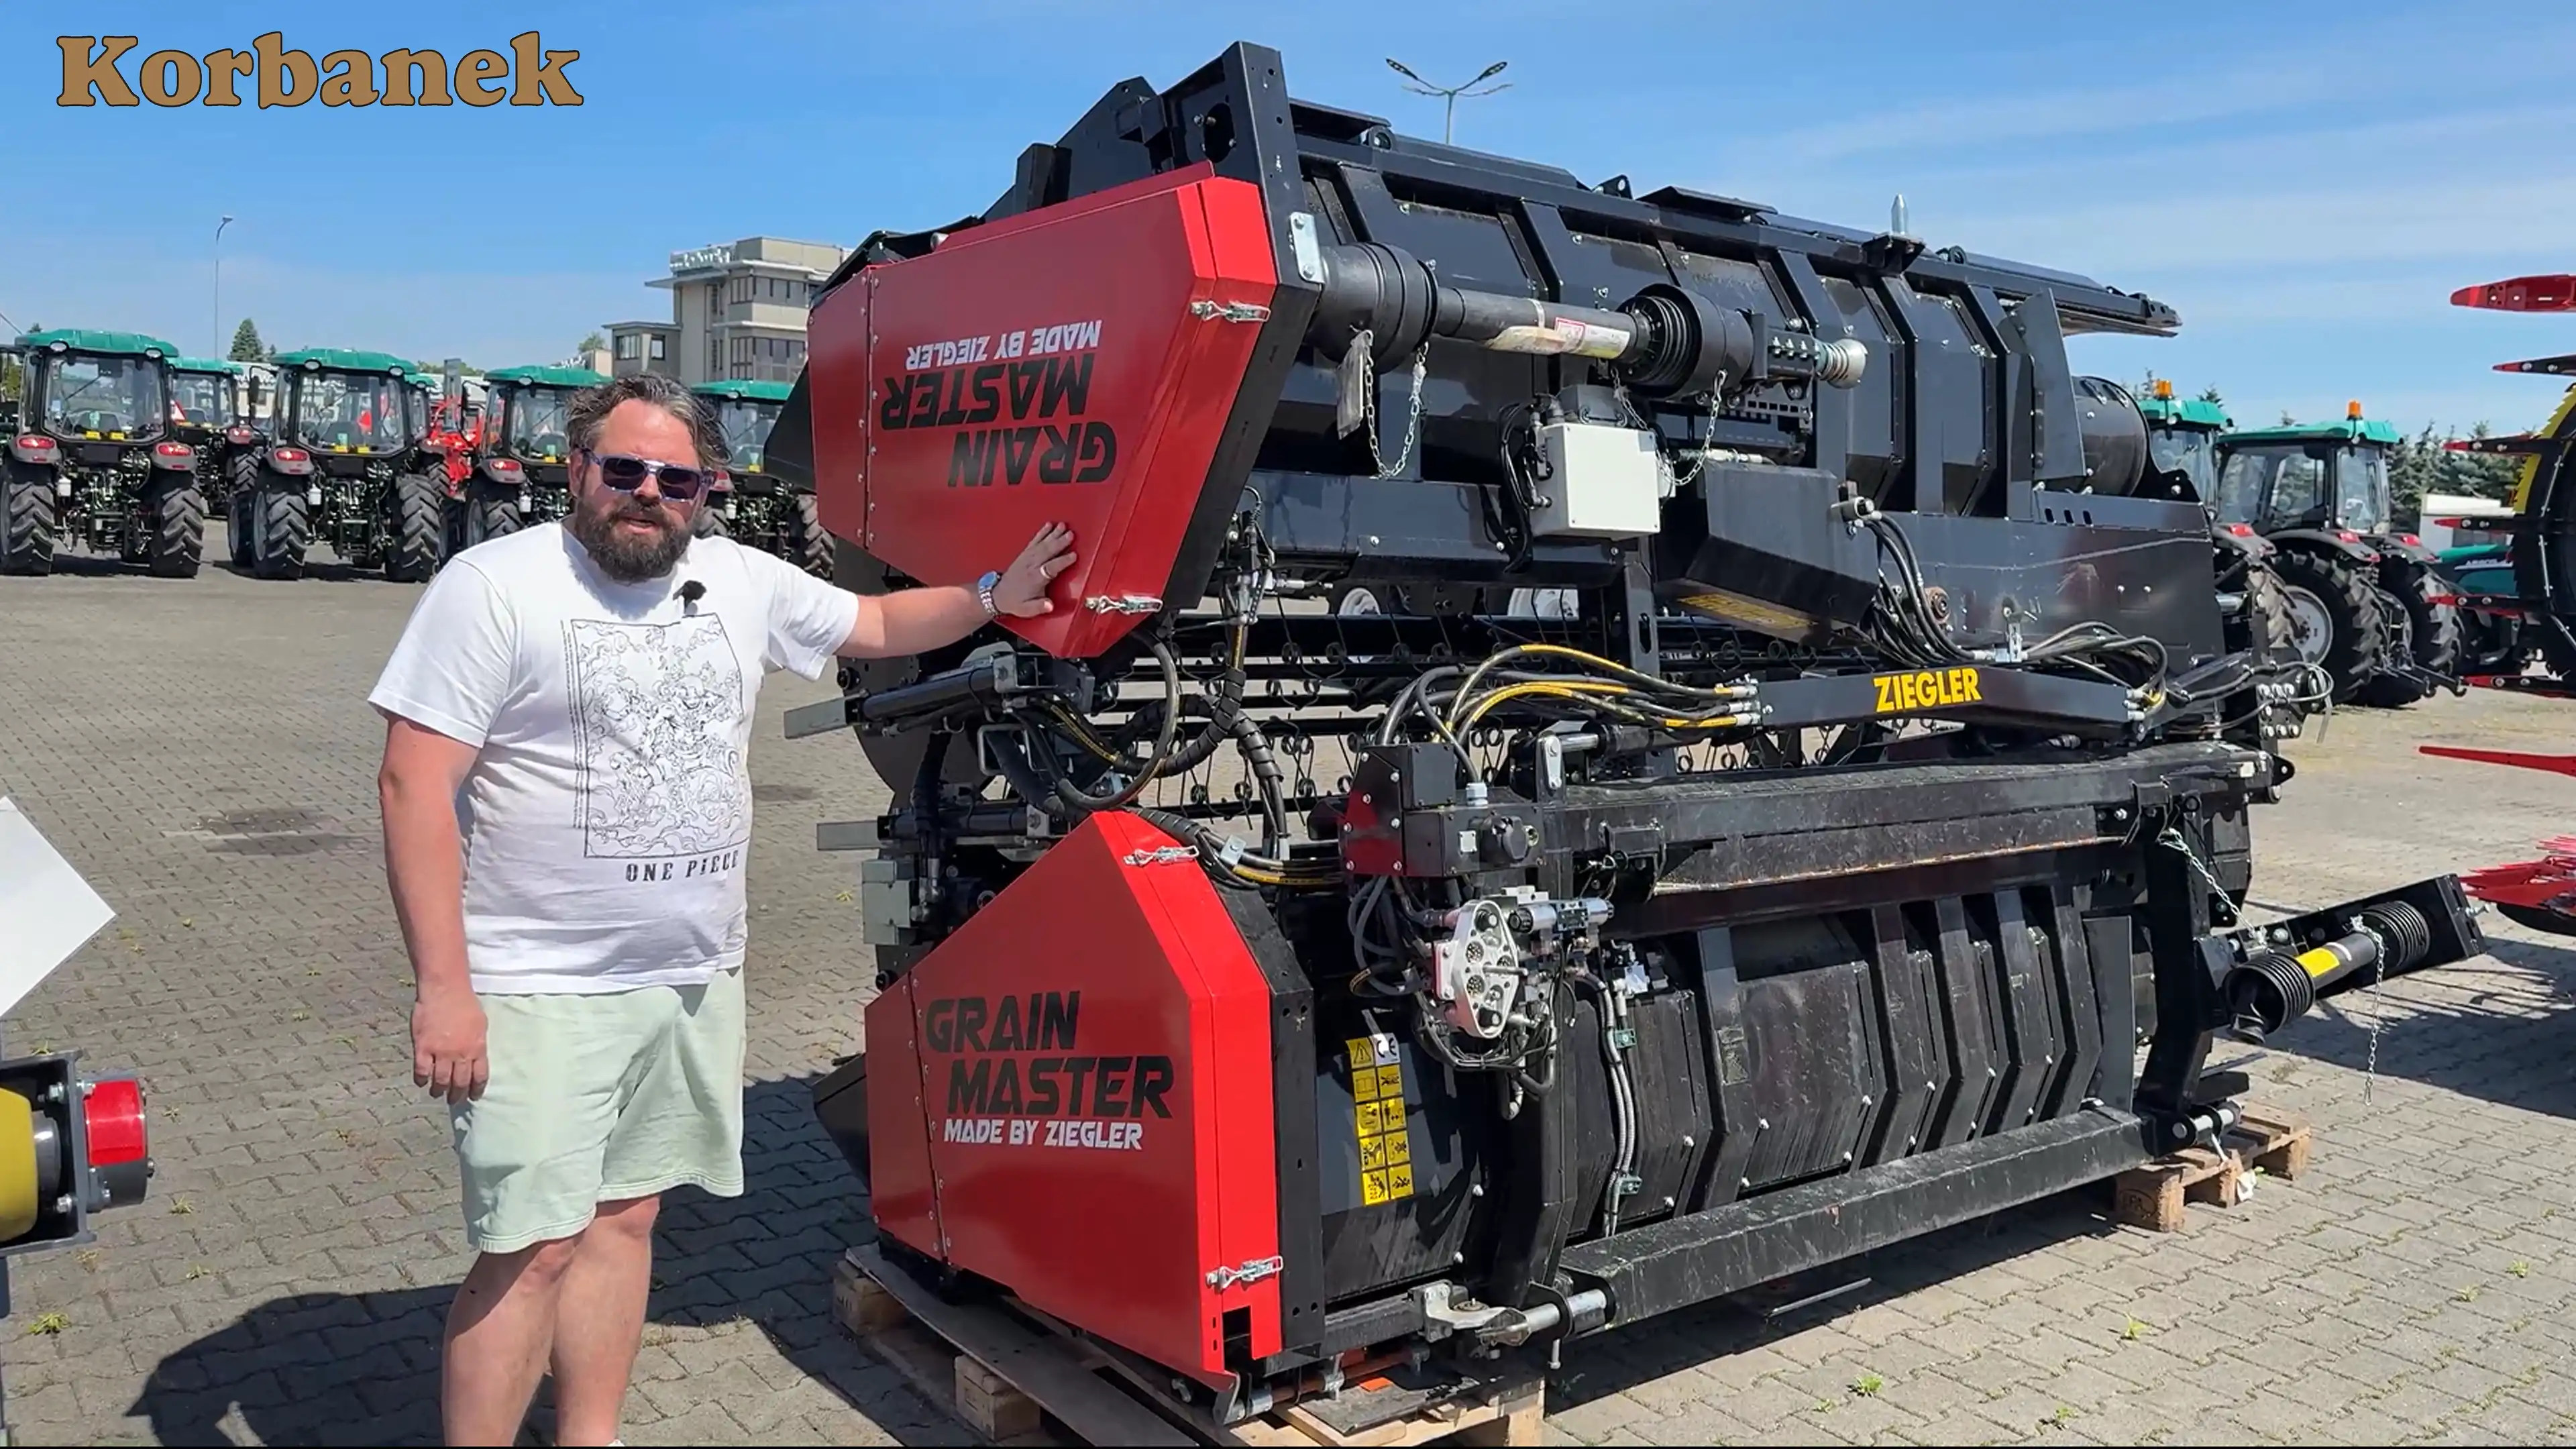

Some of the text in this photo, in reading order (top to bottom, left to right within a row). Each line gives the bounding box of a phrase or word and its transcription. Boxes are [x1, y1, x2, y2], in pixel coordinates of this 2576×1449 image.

[906, 320, 1102, 370] MADE BY ZIEGLER
[881, 353, 1095, 430] MASTER
[948, 422, 1117, 487] GRAIN
[1874, 667, 1982, 712] ZIEGLER
[625, 850, 739, 882] ONE PIECE
[926, 990, 1081, 1052] GRAIN
[947, 1055, 1174, 1119] MASTER
[944, 1118, 1143, 1150] MADE BY ZIEGLER
